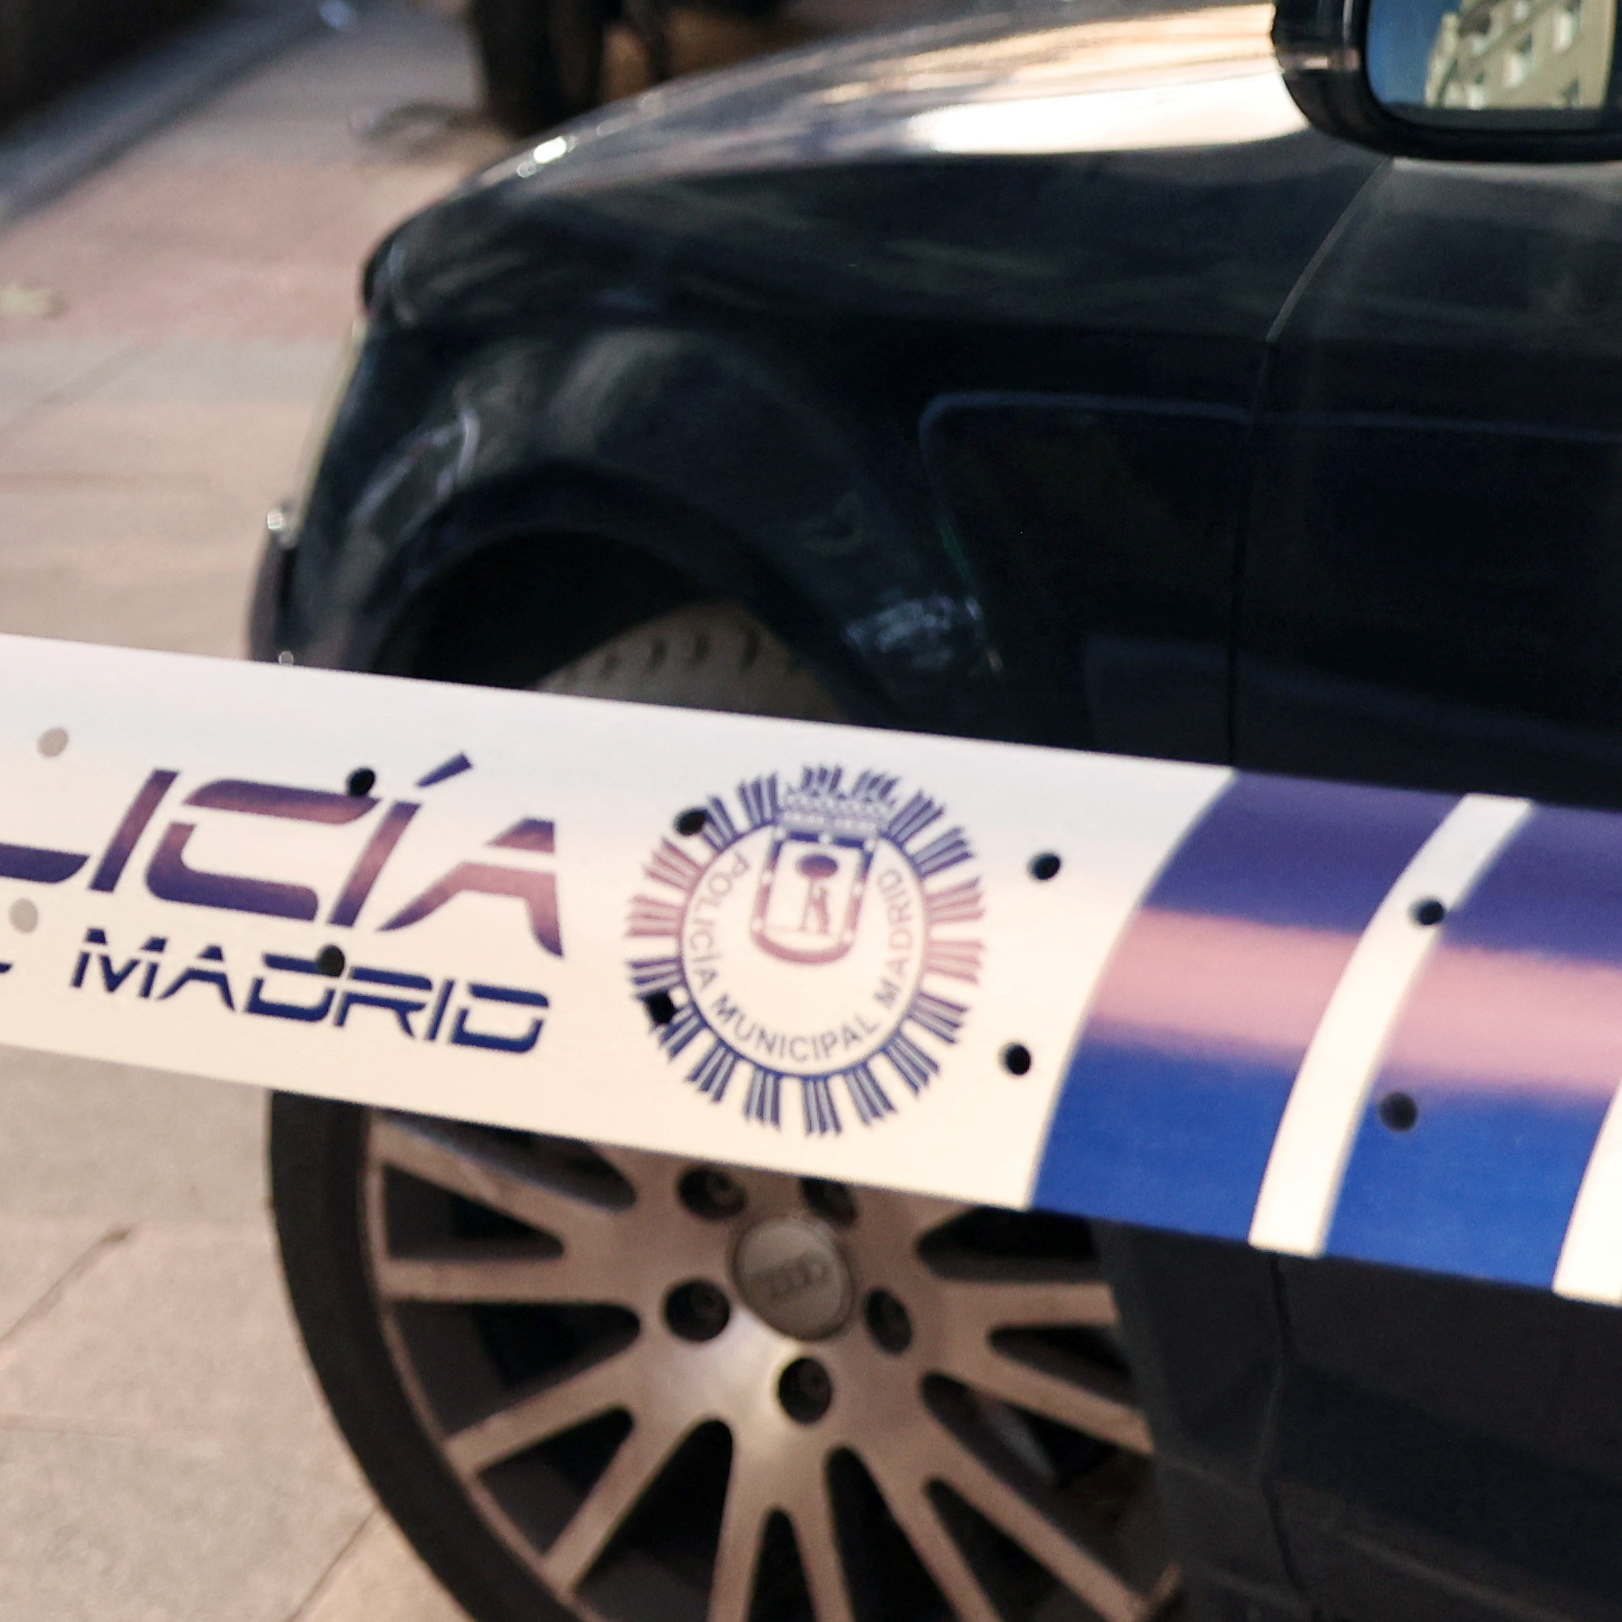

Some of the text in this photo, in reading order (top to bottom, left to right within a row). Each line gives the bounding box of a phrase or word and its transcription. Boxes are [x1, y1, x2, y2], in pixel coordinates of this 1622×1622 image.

[72, 927, 551, 1056] MADRID
[712, 993, 880, 1063] MUNICIPAL
[875, 870, 912, 1008] MADRID
